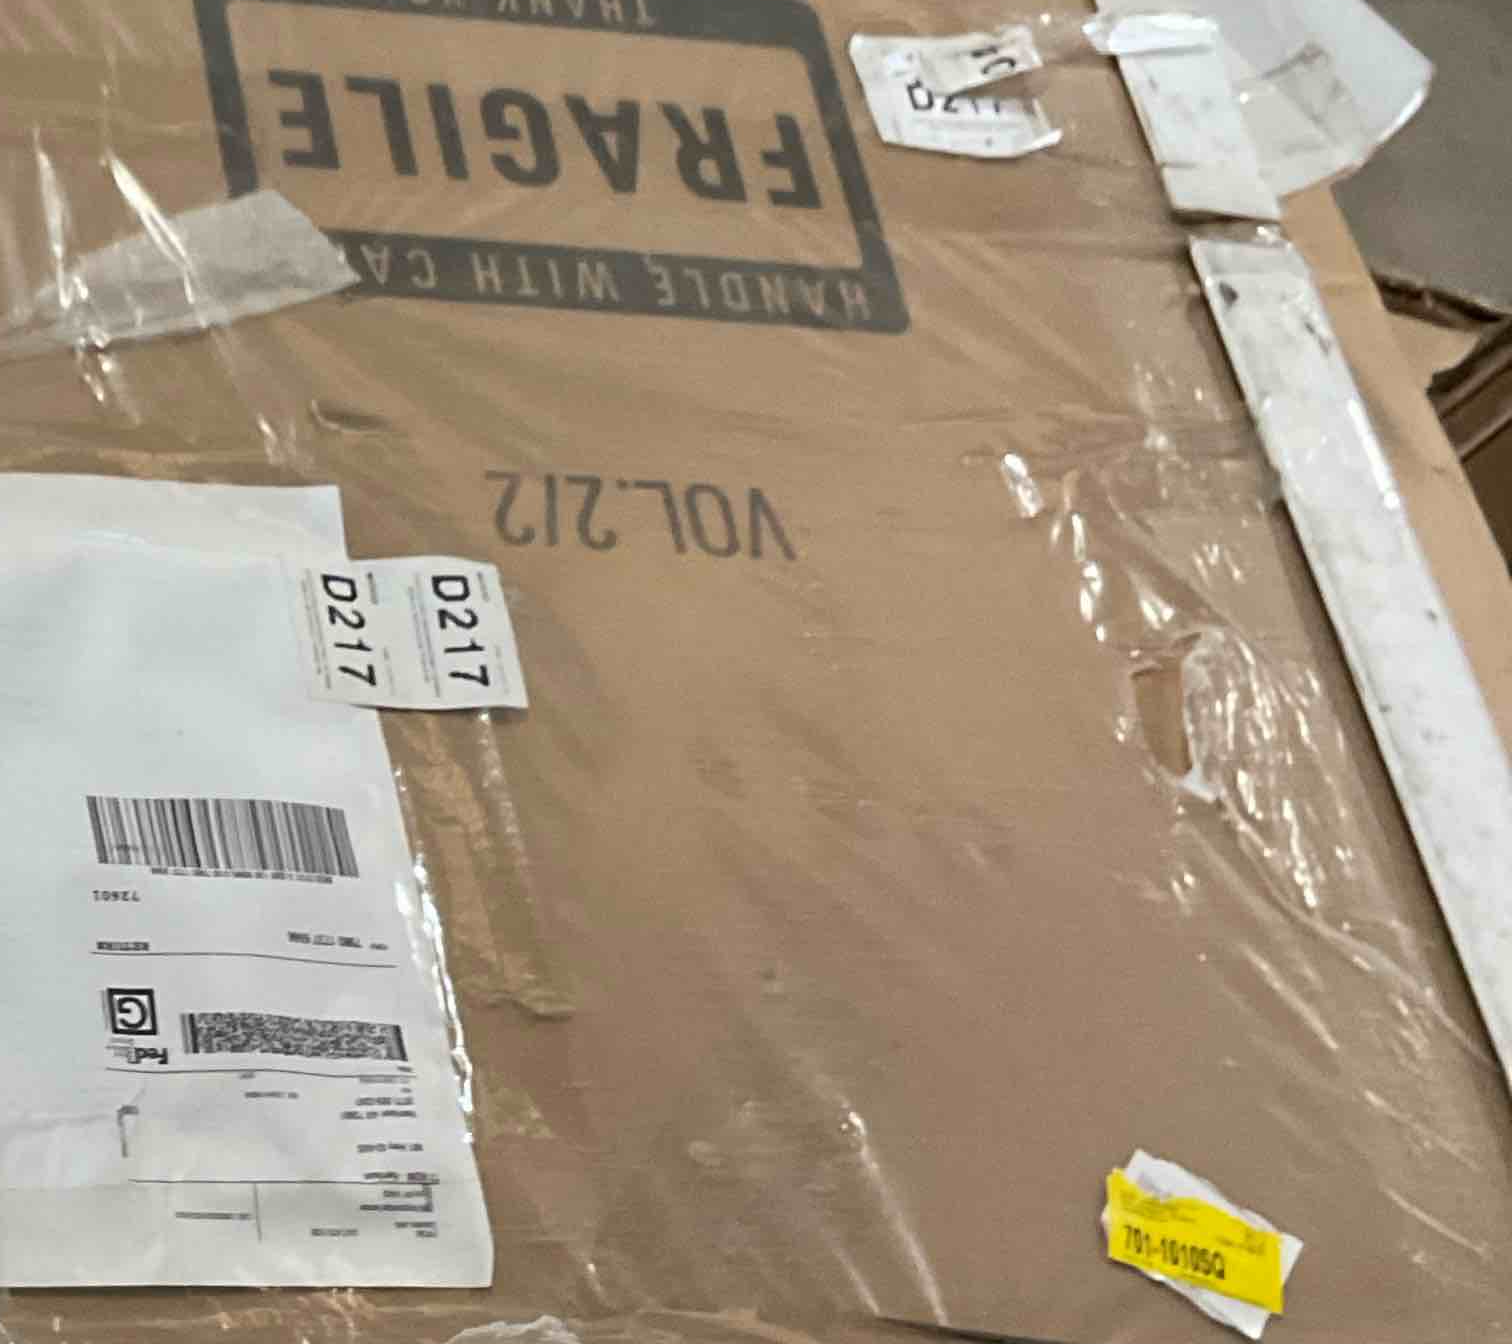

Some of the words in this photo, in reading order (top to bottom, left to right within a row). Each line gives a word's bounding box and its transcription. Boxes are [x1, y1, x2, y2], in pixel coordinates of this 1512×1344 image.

[266, 67, 823, 211] FRAGILE
[338, 242, 437, 289] CA
[472, 250, 621, 303] WITH
[655, 263, 874, 323] HANDLE
[320, 572, 378, 687] D217
[430, 574, 490, 687] D217
[116, 997, 147, 1029] G
